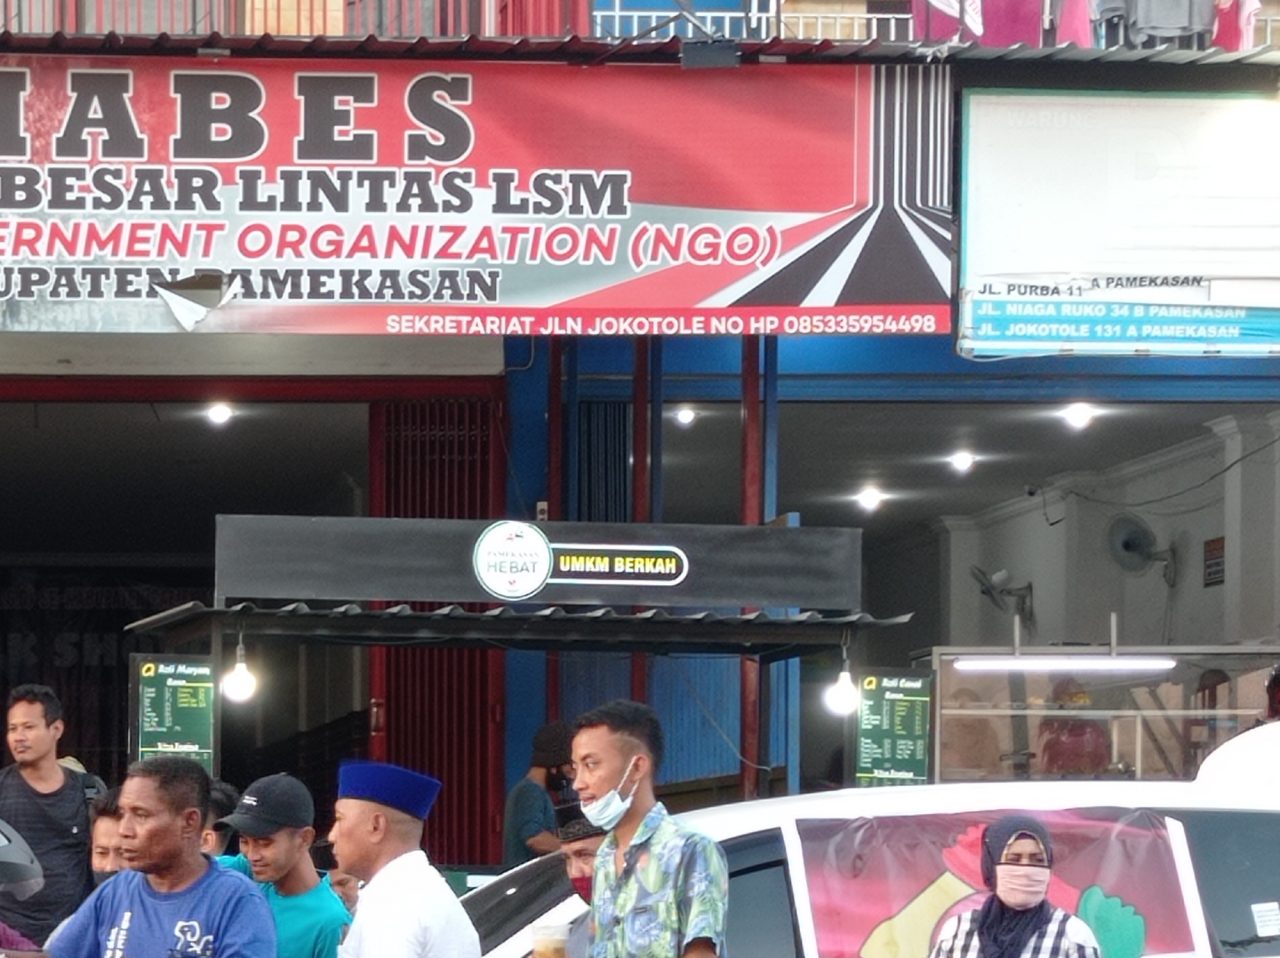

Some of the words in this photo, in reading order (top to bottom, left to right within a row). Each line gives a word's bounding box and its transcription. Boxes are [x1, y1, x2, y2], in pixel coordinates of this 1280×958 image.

[237, 168, 475, 214] LINTAS
[490, 169, 630, 216] LSM
[236, 222, 618, 263] ORGANIZATION
[630, 224, 780, 269] (NGO)
[210, 266, 500, 302] AMEKASAN
[978, 283, 1001, 296] JL.
[1006, 284, 1061, 297] PURBA
[1091, 277, 1102, 289] A
[1106, 275, 1204, 289] PAMEKASAN
[977, 302, 1001, 316] JL.
[1005, 303, 1058, 317] NIAGA
[1060, 303, 1107, 317] RUKO
[1110, 304, 1130, 317] 34
[1134, 304, 1145, 318] B
[1148, 305, 1246, 319] PAMEKASAN
[385, 314, 535, 335] SEKRETARIAT
[539, 316, 583, 335] JLN
[587, 316, 708, 335] JOKOTOLE
[709, 316, 744, 335] NO
[749, 316, 779, 334] HP
[784, 314, 937, 334] 085335954498
[977, 323, 1001, 336] JL.
[1004, 323, 1090, 337] JOKOTOLE
[1094, 324, 1121, 337] 131
[1125, 324, 1137, 337] A
[1141, 324, 1241, 338] PAMEKASAN
[486, 559, 540, 575] HEBAT
[558, 554, 610, 573] UMKM
[613, 556, 678, 575] BERKAH
